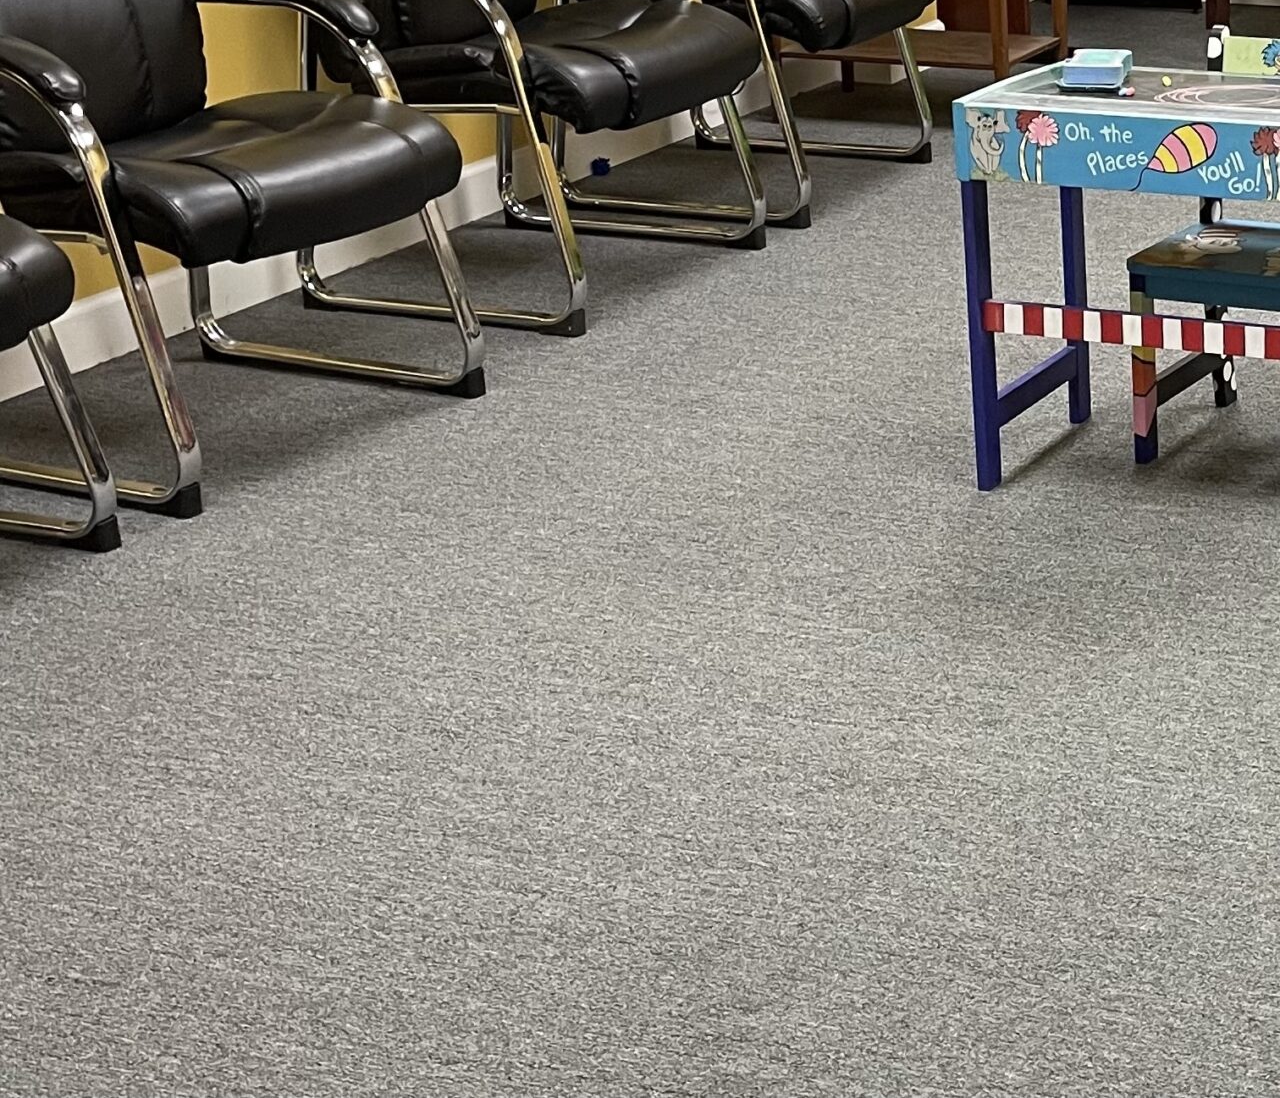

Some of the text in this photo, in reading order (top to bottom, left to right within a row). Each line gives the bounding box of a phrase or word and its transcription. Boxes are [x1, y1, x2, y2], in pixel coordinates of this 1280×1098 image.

[1100, 123, 1133, 144] the
[1086, 152, 1149, 176] Places
[1197, 151, 1245, 184] You'll
[1228, 163, 1262, 195] Go!
